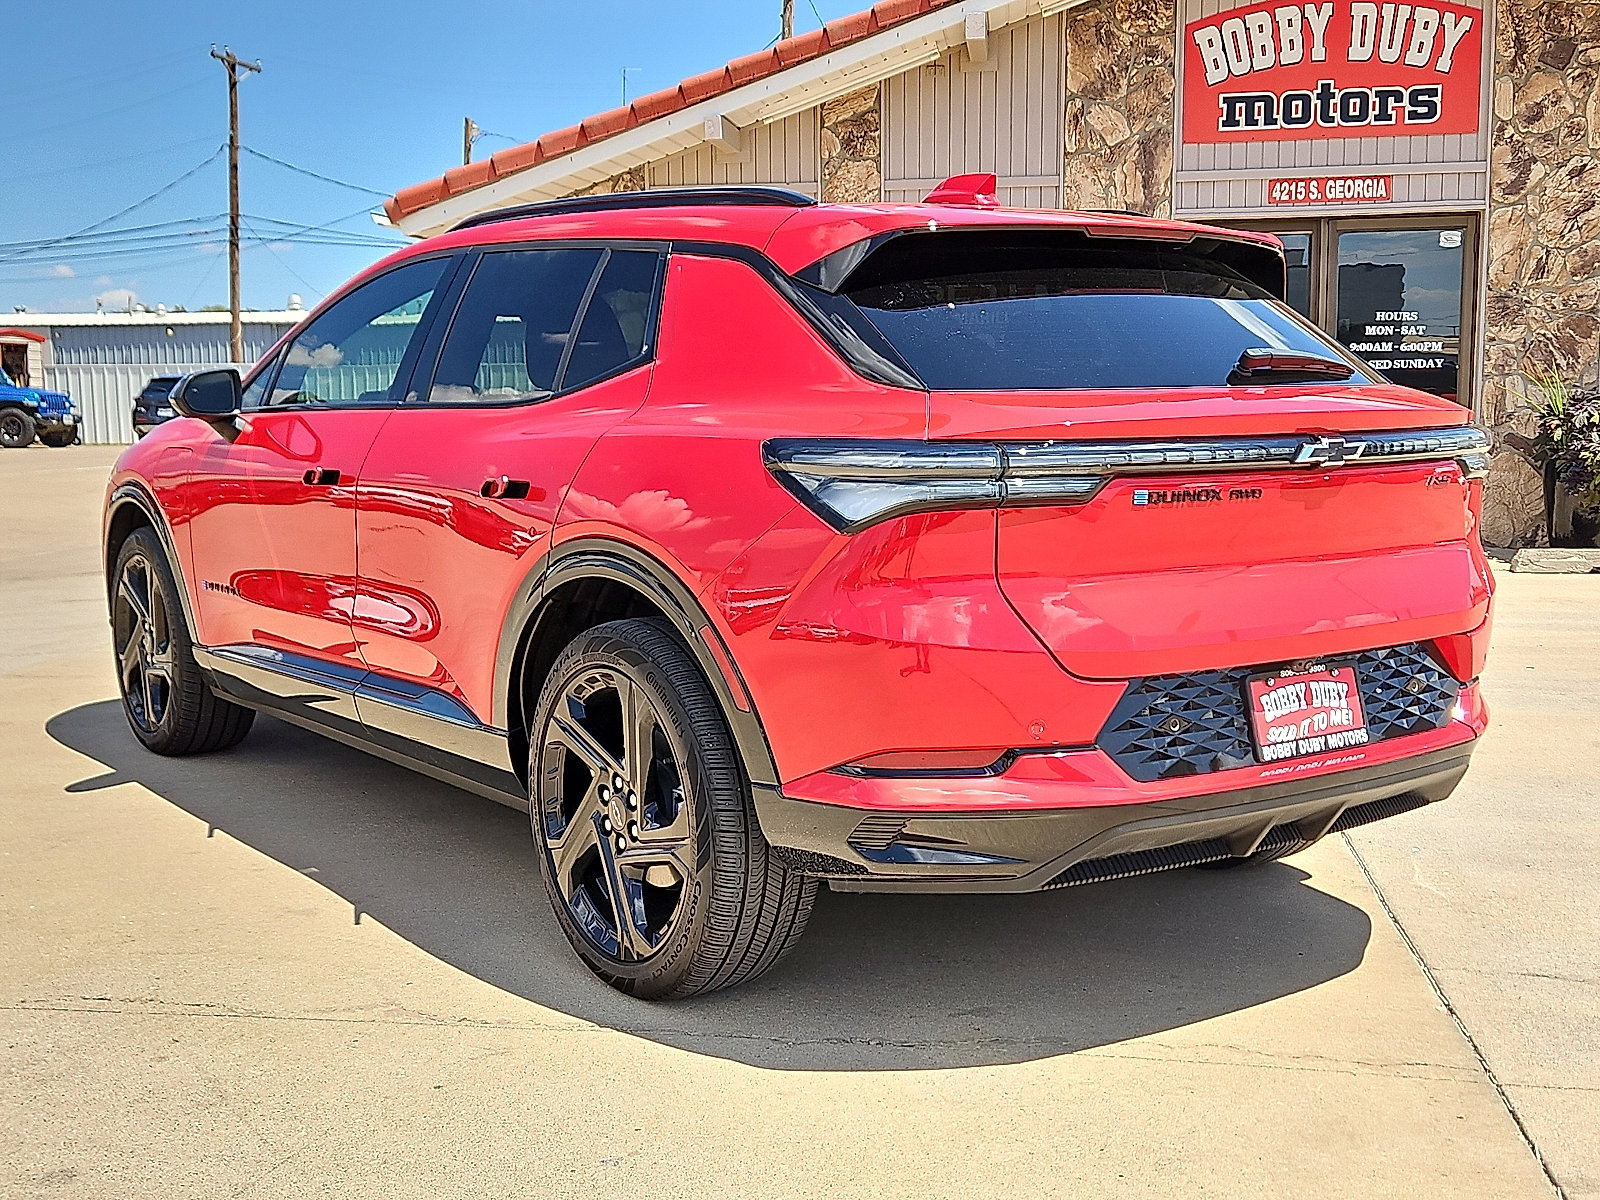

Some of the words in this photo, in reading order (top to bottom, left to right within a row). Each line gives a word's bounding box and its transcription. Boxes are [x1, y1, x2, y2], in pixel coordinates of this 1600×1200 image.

[1193, 2, 1334, 86] BOBBY
[1348, 2, 1474, 74] DUBY
[1219, 79, 1442, 131] motors
[1272, 181, 1306, 201] 4215
[1309, 180, 1322, 200] S.
[1326, 178, 1387, 199] GEORGIA
[1375, 311, 1418, 321] HOURS
[1367, 359, 1392, 370] SED
[1393, 358, 1445, 369] SUNDAY
[1132, 488, 1223, 506] EQUINOX
[1259, 682, 1307, 723] BOBBY
[1309, 680, 1349, 709] DUBY
[1267, 723, 1297, 743] SOLD
[1299, 717, 1312, 739] IT
[1312, 711, 1328, 732] TO
[1261, 740, 1297, 761] BOBBY
[1298, 736, 1326, 755] DUBY
[1326, 727, 1369, 750] MOTORS
